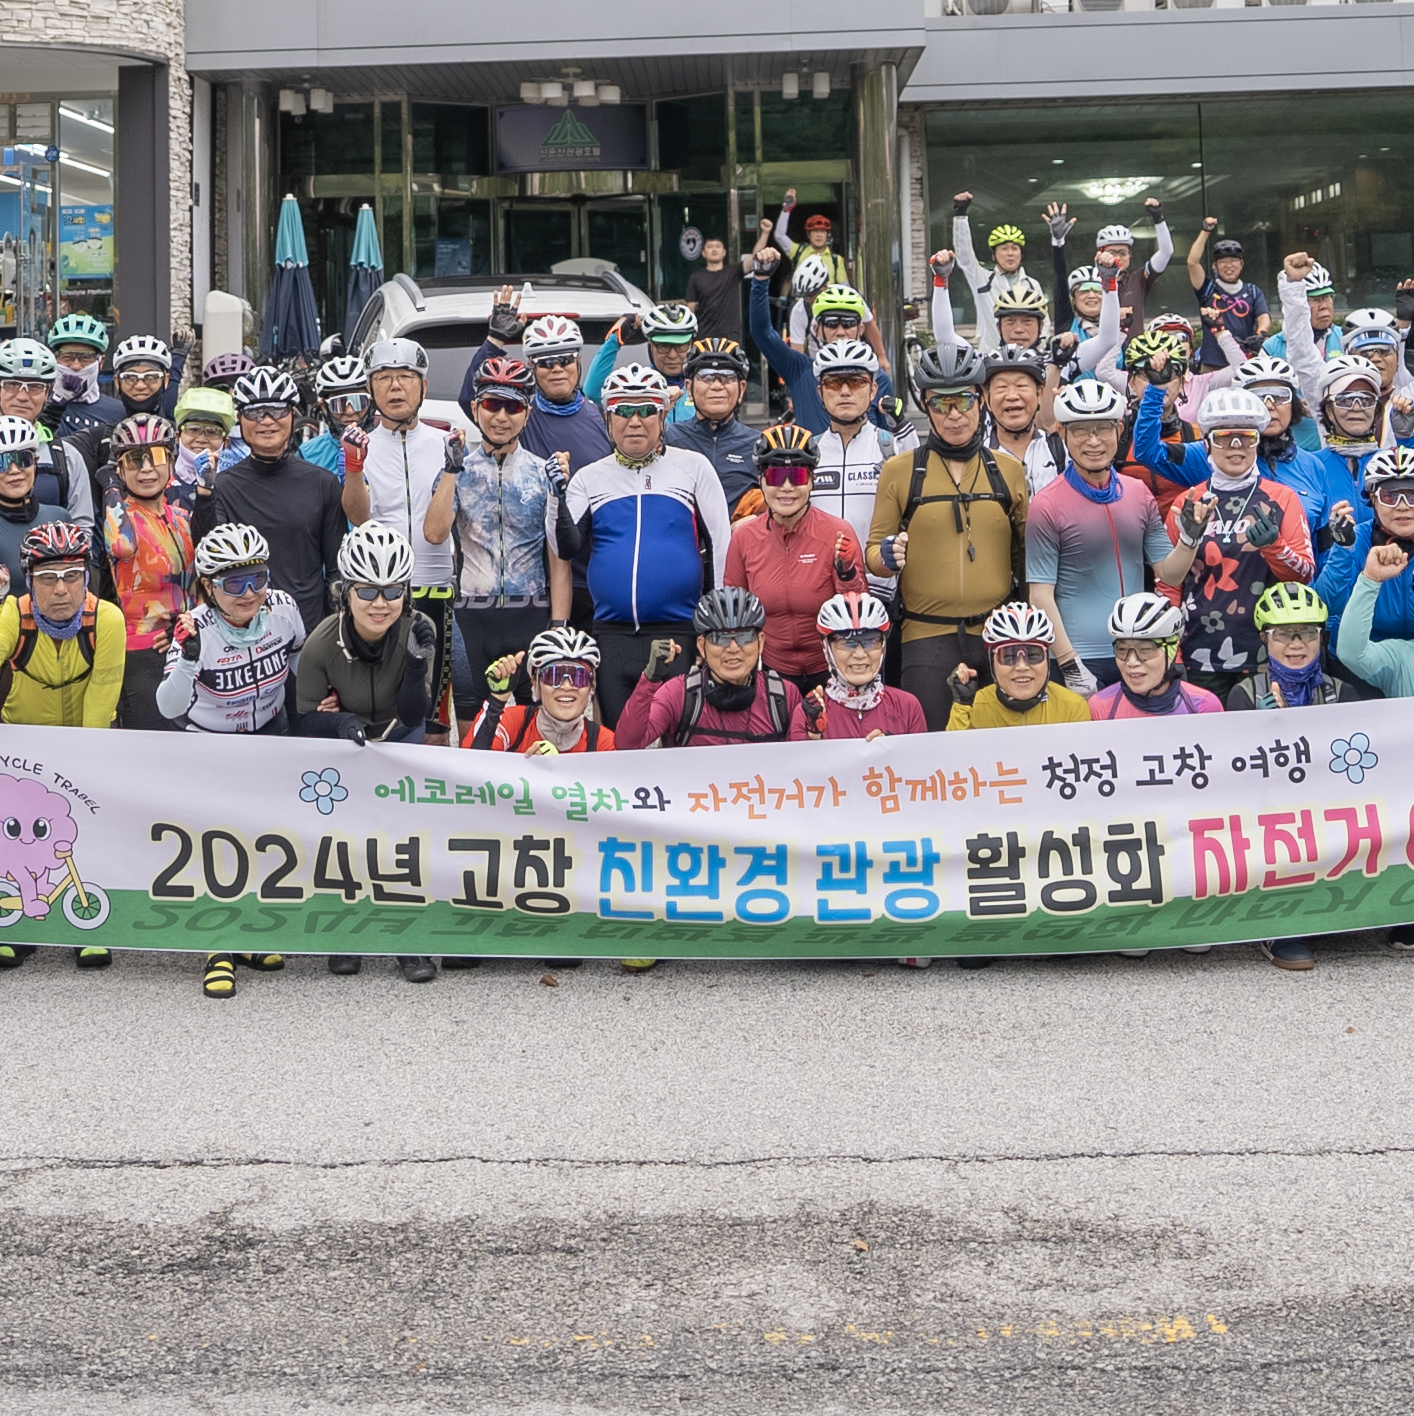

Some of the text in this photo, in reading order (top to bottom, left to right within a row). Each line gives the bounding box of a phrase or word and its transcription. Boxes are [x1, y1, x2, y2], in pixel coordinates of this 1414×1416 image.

[53, 772, 101, 815] TRABEL
[374, 775, 536, 816] 에코레일
[688, 774, 847, 820] 자전거가
[862, 760, 1027, 815] 함께하는
[1042, 750, 1119, 800] 청정
[1134, 744, 1213, 790] 고창
[1231, 734, 1313, 784] 여행
[150, 822, 427, 905] 2024년
[445, 832, 574, 914] 고창
[598, 836, 793, 924] 친환경
[815, 836, 941, 921] 관광
[965, 820, 1166, 918] 활성화
[1188, 801, 1384, 900] 자전거
